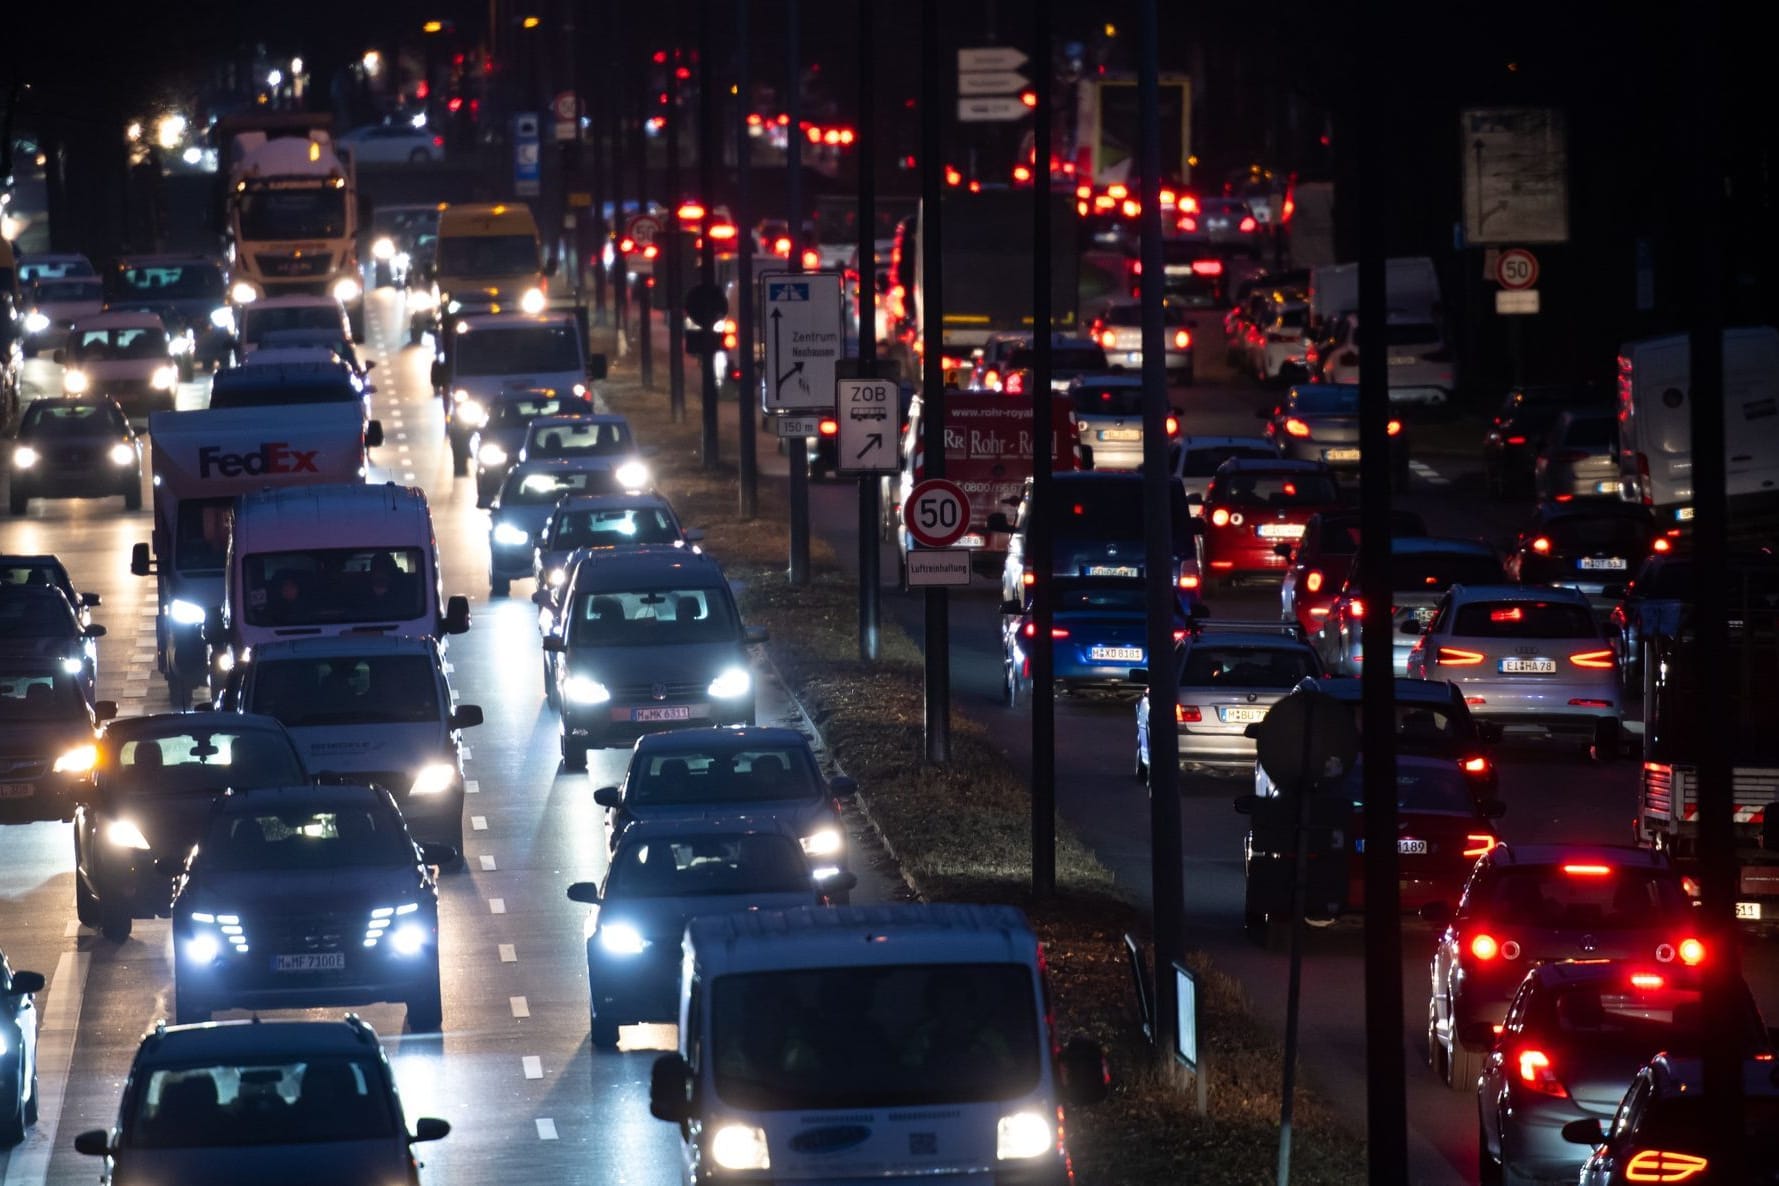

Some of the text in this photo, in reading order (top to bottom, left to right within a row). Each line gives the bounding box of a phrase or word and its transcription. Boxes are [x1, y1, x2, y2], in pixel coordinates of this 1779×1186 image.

[1506, 261, 1528, 279] 50
[792, 331, 837, 342] Zentrum
[851, 386, 887, 401] ZOB
[951, 407, 1033, 420] www.rohr-royal
[784, 421, 814, 432] 150 m
[970, 430, 1006, 455] Rohr
[199, 443, 319, 478] FedEx
[920, 498, 957, 528] 50
[911, 563, 967, 574] Luftreinhaltung
